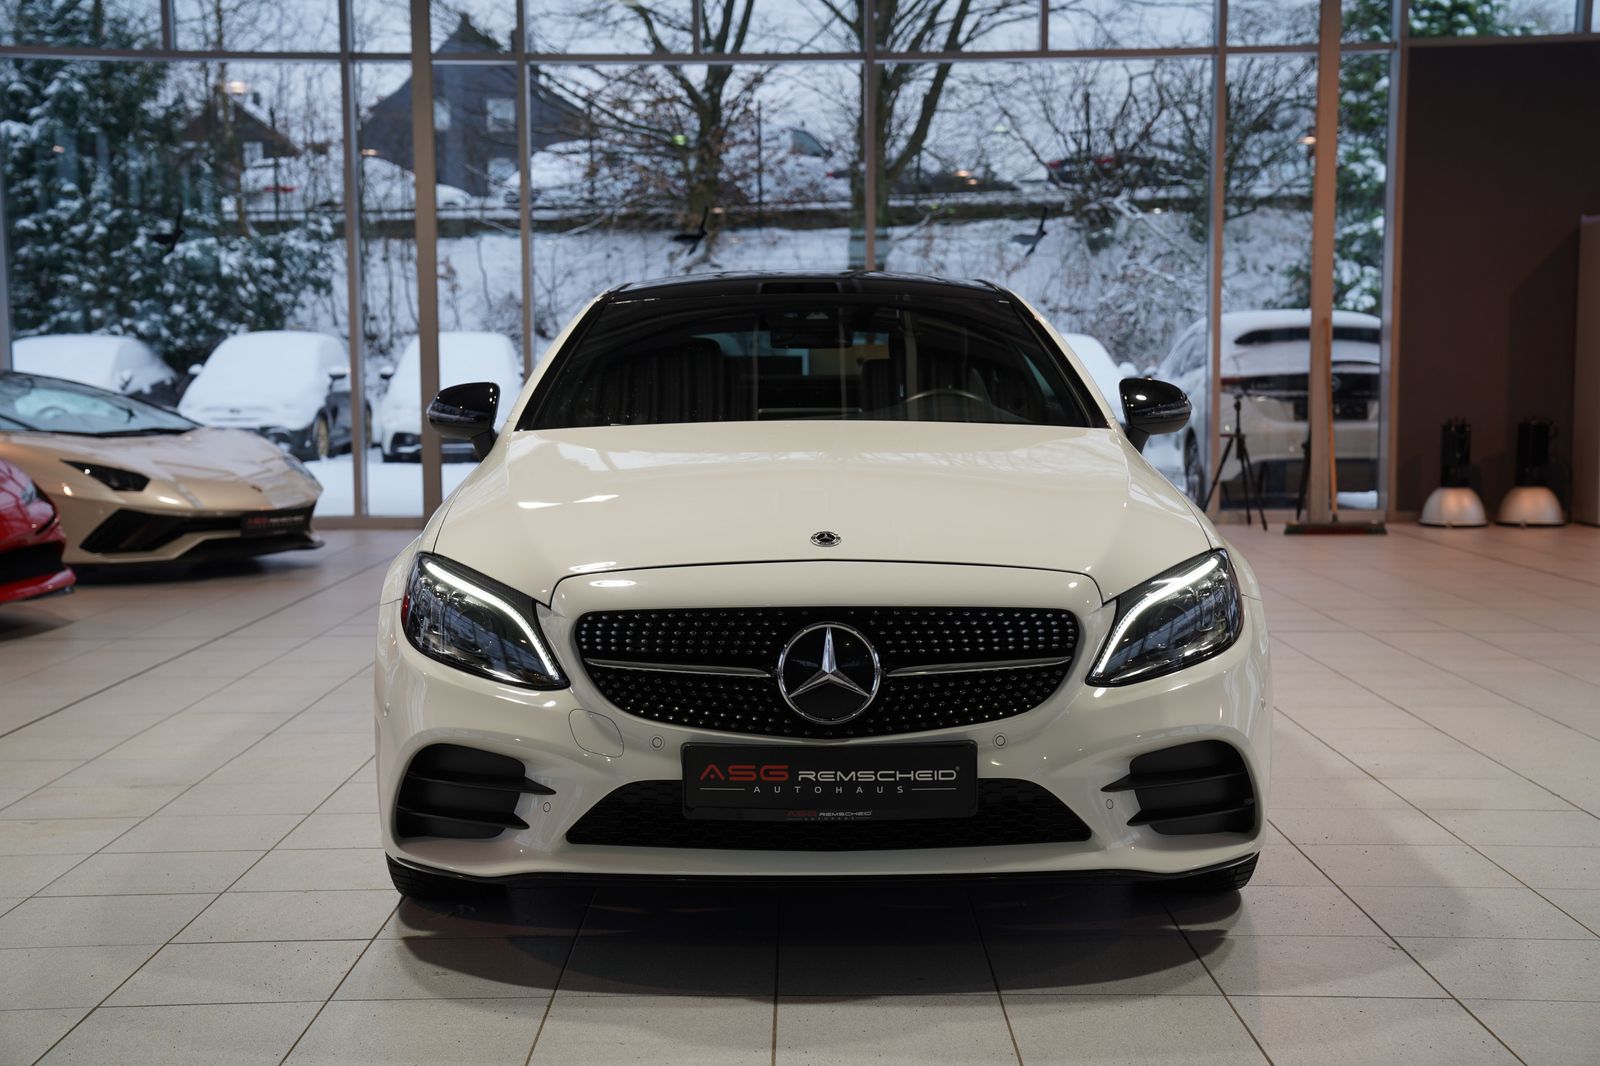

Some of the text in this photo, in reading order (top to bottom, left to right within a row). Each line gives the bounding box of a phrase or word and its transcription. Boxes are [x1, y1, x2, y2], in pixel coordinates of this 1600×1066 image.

[700, 764, 957, 782] ASG REMSCHEID
[753, 786, 904, 794] AUTOHAUS
